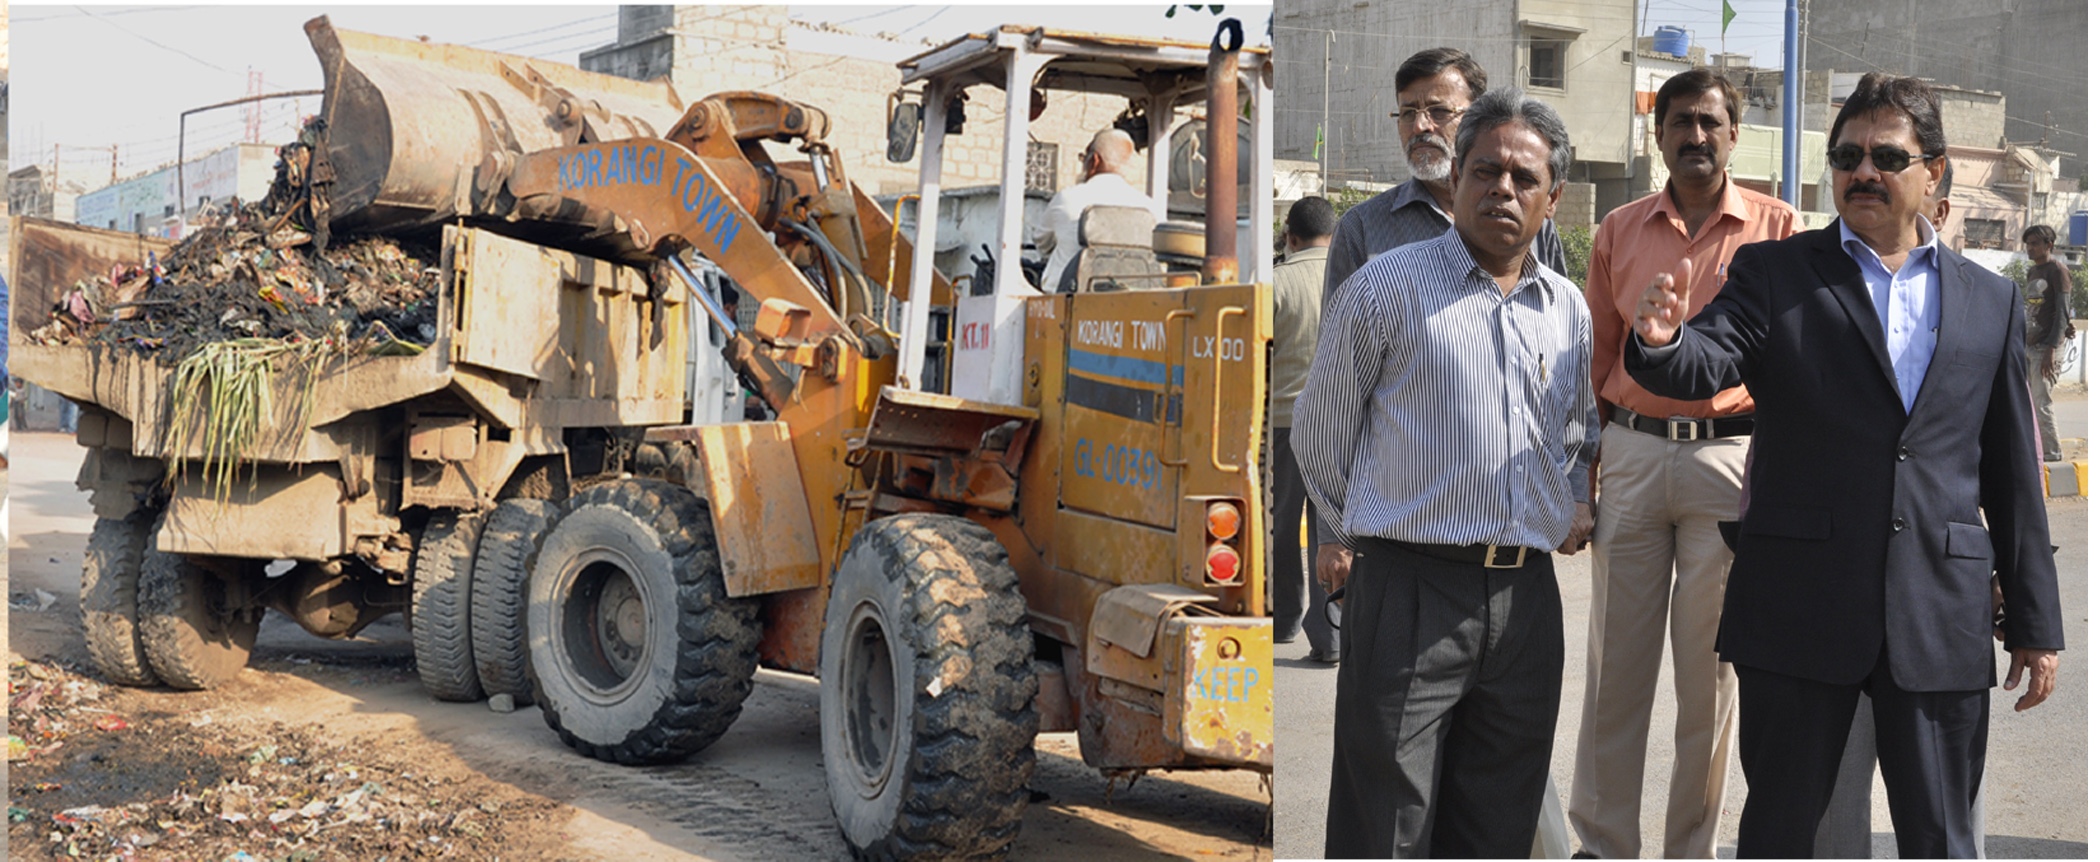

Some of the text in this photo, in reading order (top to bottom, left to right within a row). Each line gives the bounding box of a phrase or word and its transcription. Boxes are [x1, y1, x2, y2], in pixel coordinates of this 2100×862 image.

[558, 145, 741, 254] KORANGI TOWN
[1077, 320, 1124, 349] KORANGI
[1193, 336, 1244, 361] LX00
[1191, 667, 1259, 702] KEEP
